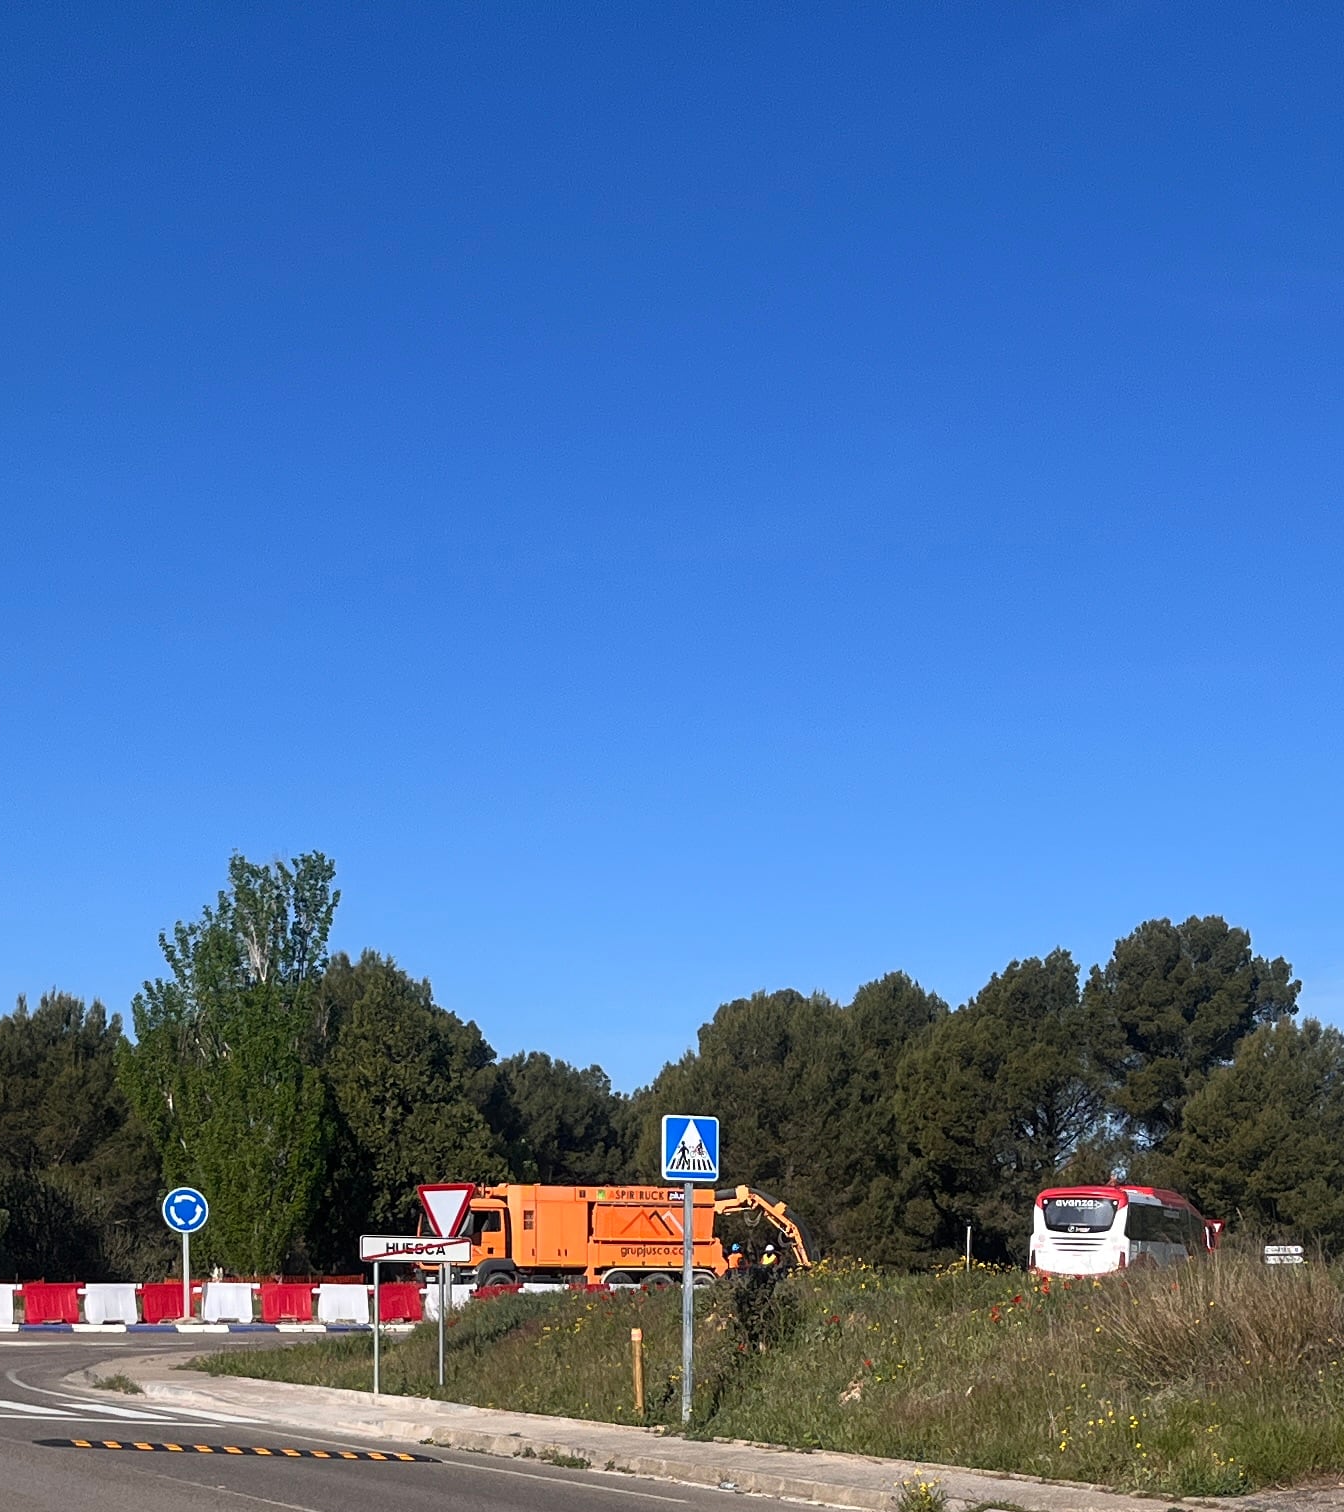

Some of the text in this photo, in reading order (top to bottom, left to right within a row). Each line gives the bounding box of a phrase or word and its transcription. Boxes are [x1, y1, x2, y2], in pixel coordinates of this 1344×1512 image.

[1055, 1199, 1094, 1207] avanza
[385, 1242, 446, 1256] HUESCA
[620, 1244, 694, 1258] grupjusca.co
